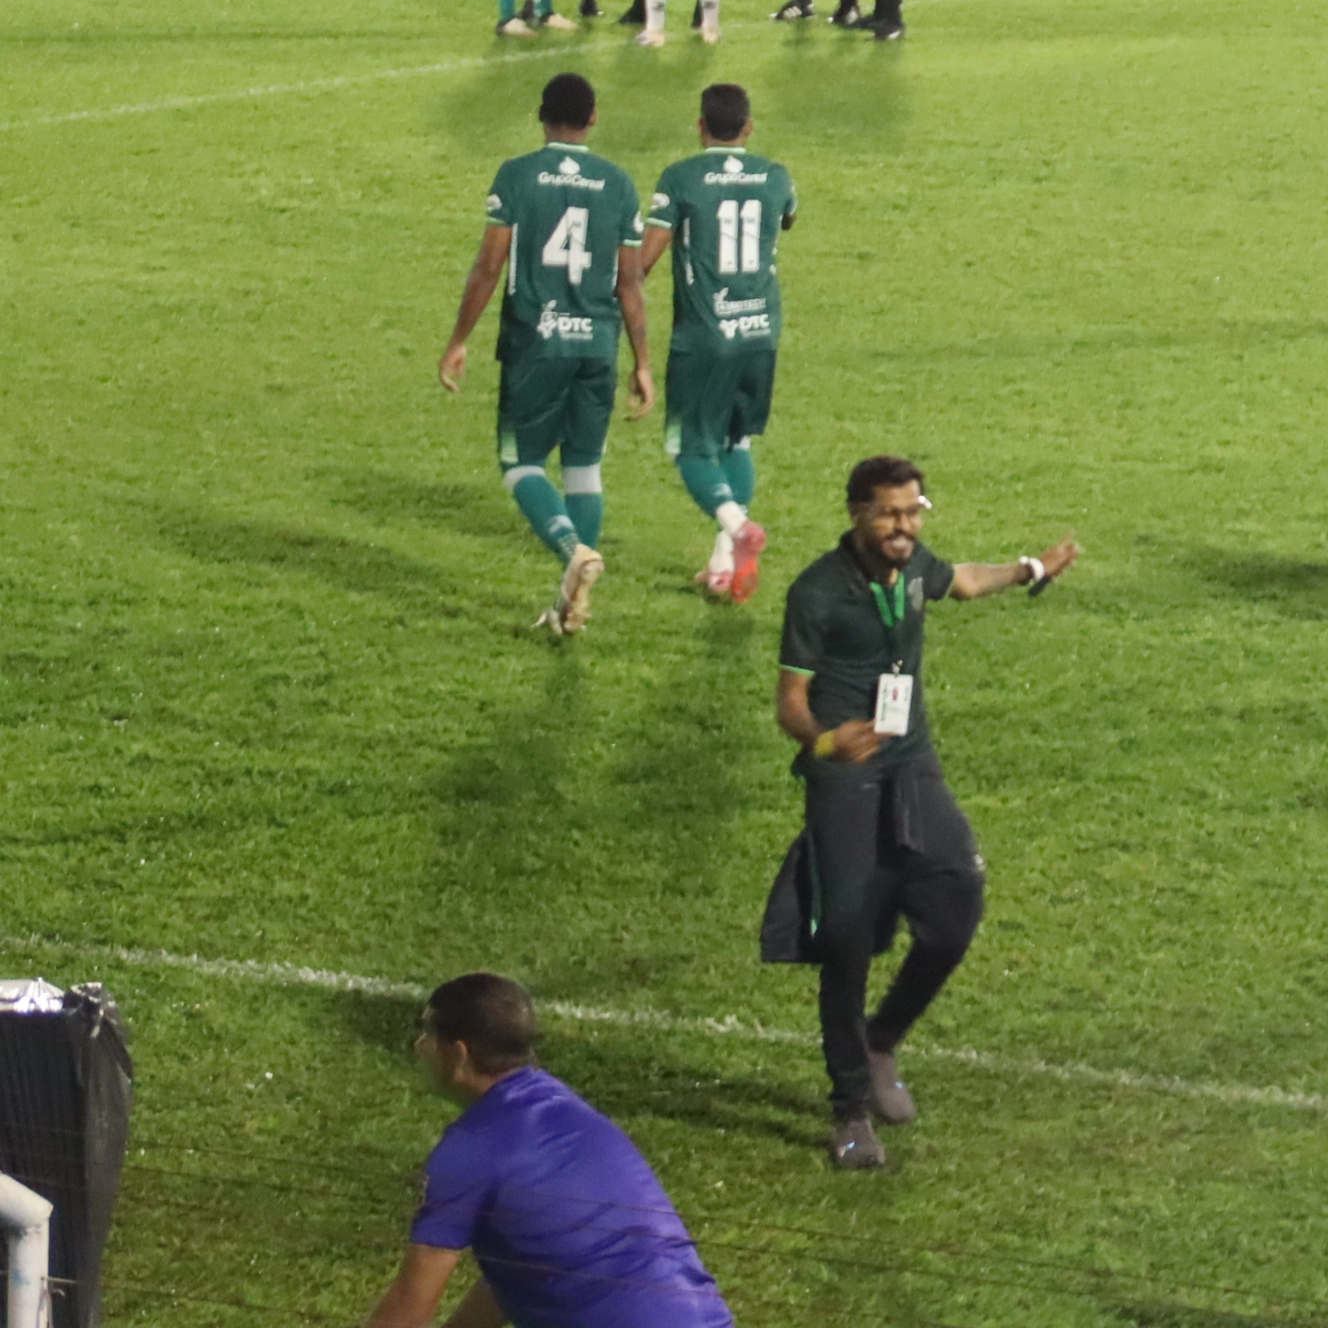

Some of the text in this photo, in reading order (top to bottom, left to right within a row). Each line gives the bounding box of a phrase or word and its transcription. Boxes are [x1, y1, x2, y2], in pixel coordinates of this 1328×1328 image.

[542, 206, 592, 286] 4
[716, 199, 762, 275] 11
[558, 317, 593, 333] DTC
[739, 313, 770, 331] DTC
